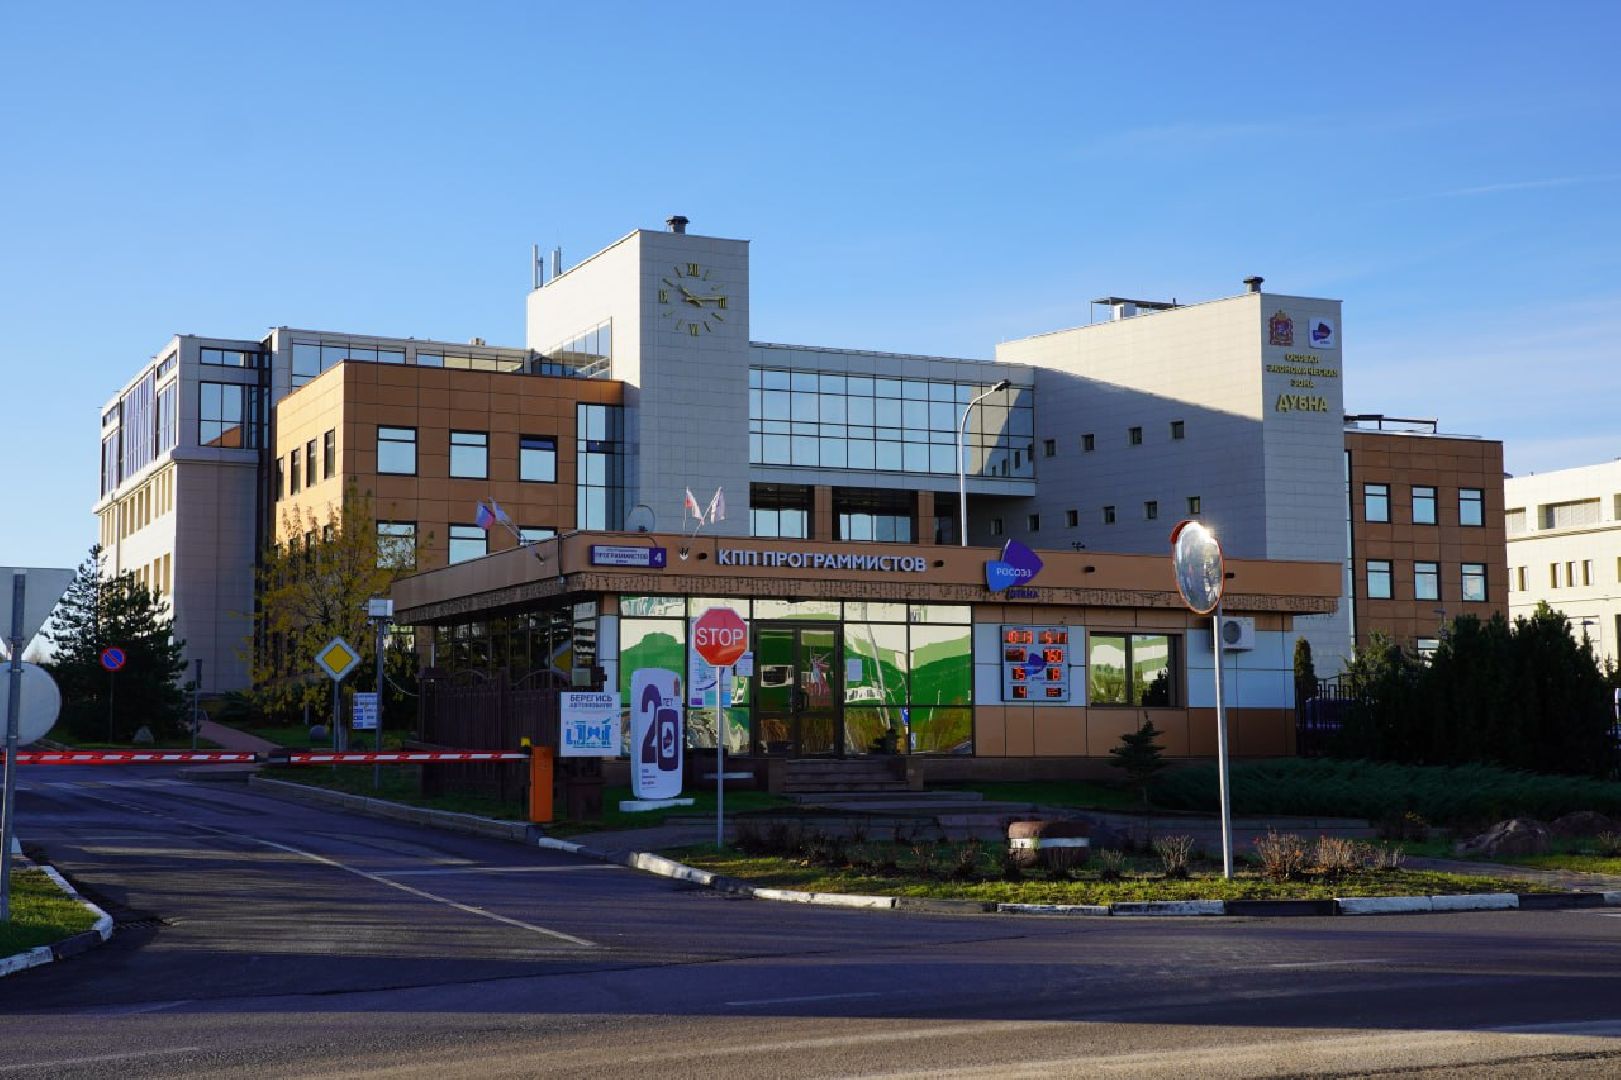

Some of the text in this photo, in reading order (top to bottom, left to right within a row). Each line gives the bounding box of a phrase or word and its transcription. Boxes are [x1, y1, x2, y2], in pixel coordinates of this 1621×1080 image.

[1276, 394, 1328, 413] ДУБНА
[654, 552, 662, 563] 4
[718, 549, 926, 572] КПП ПРОГРАММИСТОВ
[697, 627, 743, 646] STOP
[570, 694, 612, 702] БЕРЕГИСЬ
[642, 684, 679, 772] 20
